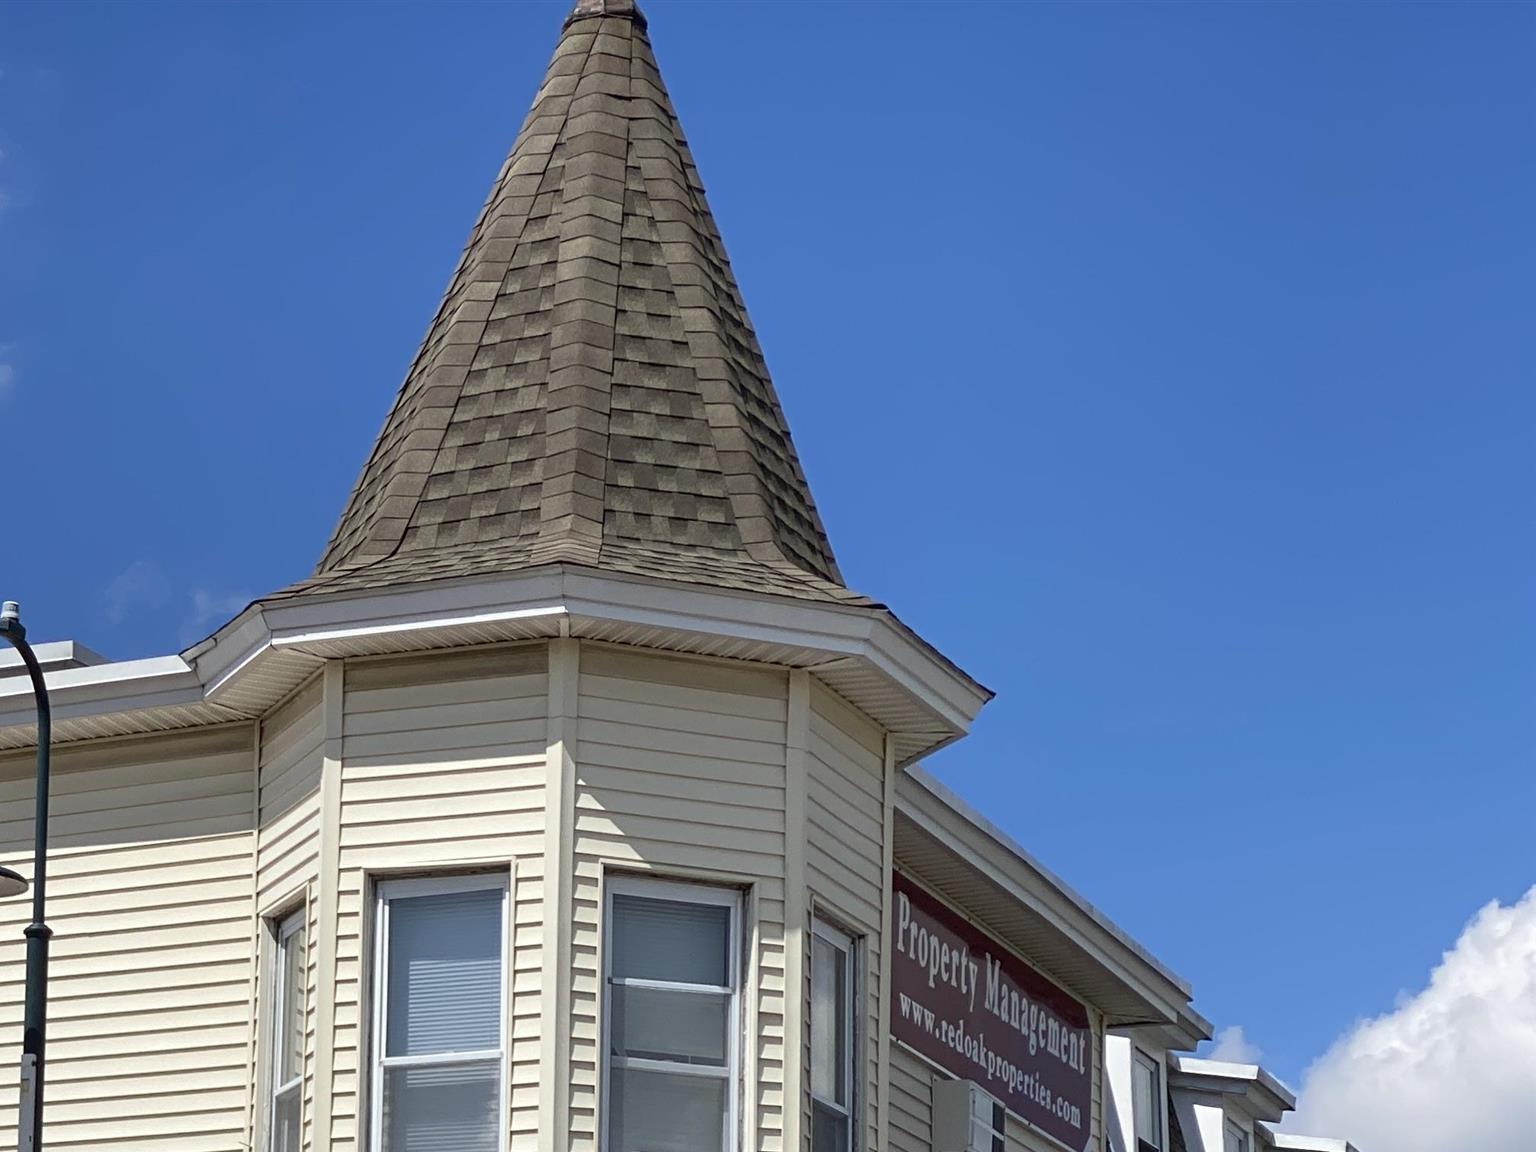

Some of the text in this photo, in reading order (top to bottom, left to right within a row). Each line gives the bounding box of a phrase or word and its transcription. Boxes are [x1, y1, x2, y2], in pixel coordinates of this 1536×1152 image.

[897, 890, 1086, 1076] Property Management
[899, 991, 1082, 1130] www.redoakproperties.com
